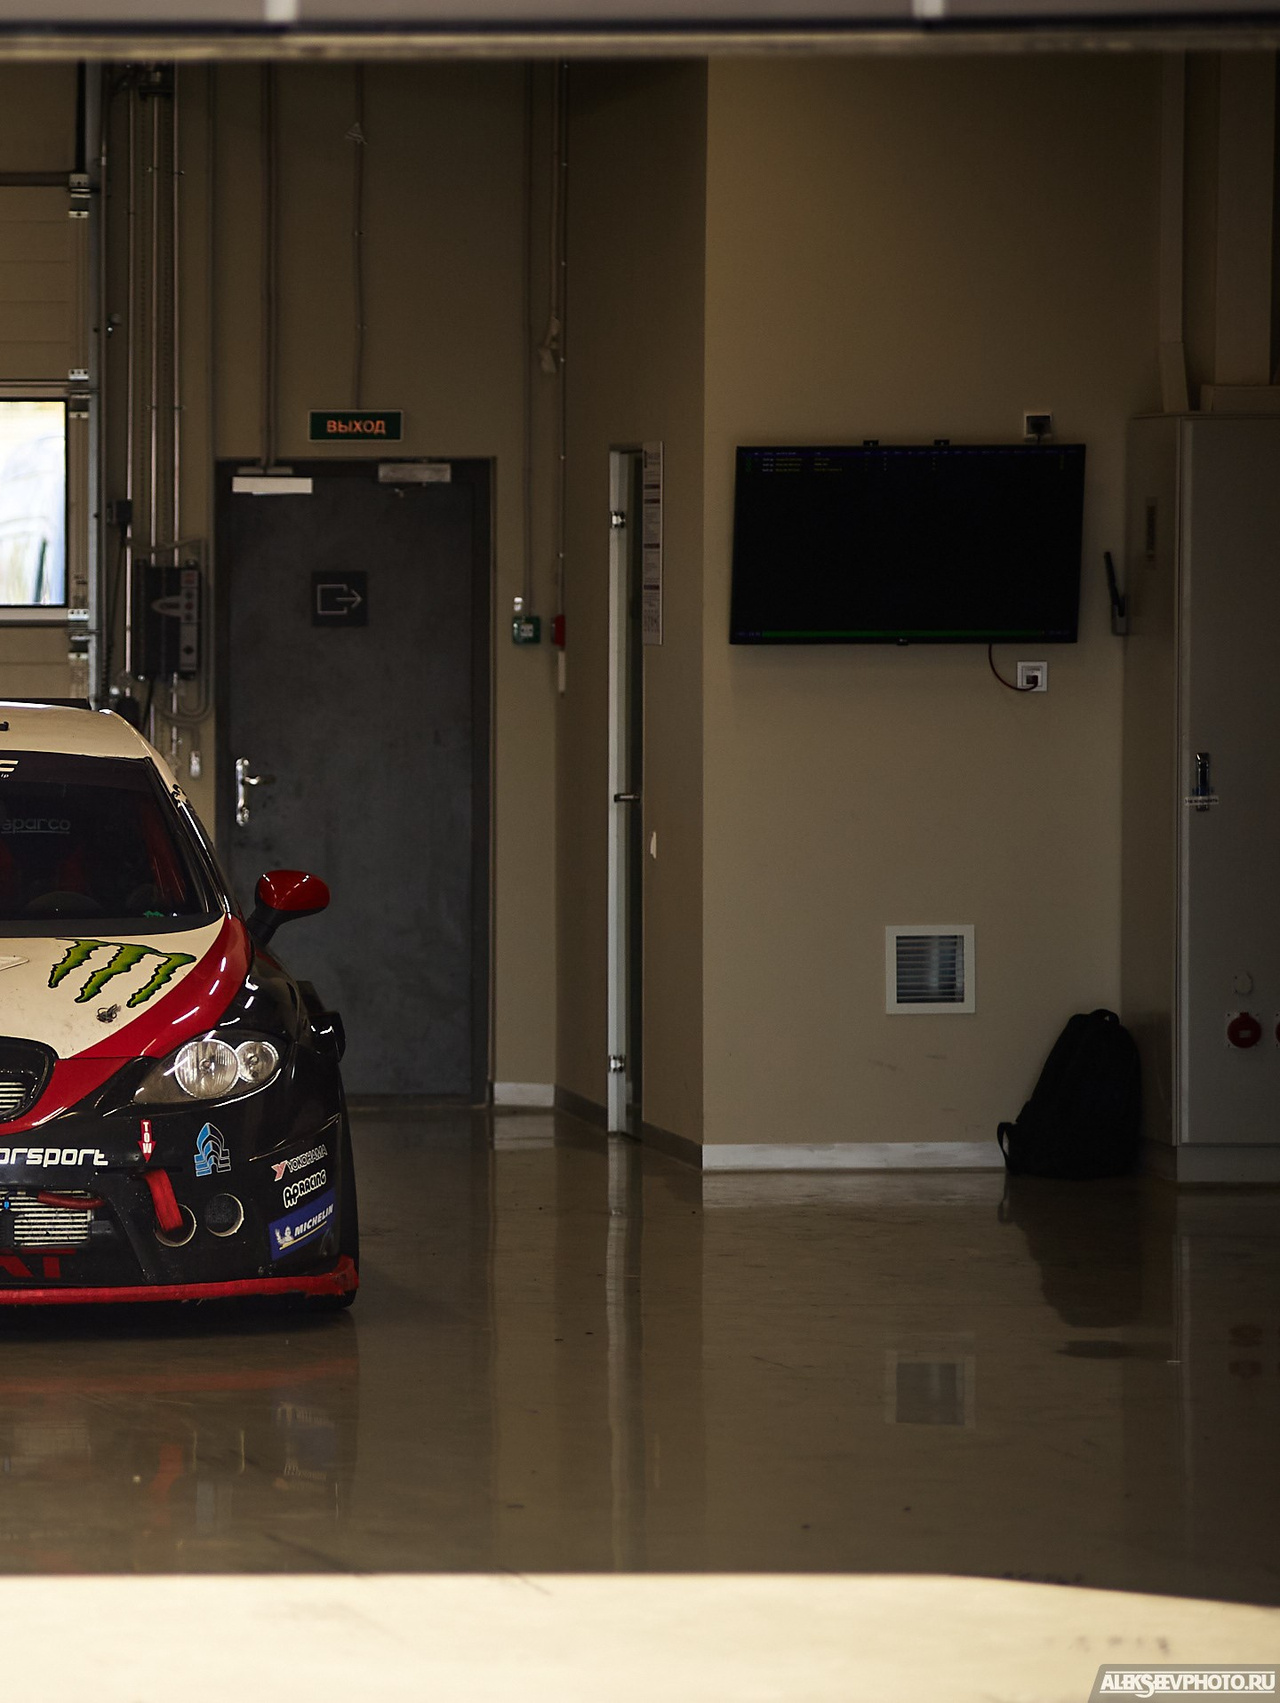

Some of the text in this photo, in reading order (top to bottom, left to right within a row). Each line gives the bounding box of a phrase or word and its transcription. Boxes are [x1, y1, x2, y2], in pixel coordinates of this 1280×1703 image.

[326, 419, 386, 435] ВЫХОД
[142, 1121, 153, 1154] TOW
[286, 1144, 328, 1173] YOKOHAMA
[294, 1203, 334, 1237] MICHELIN
